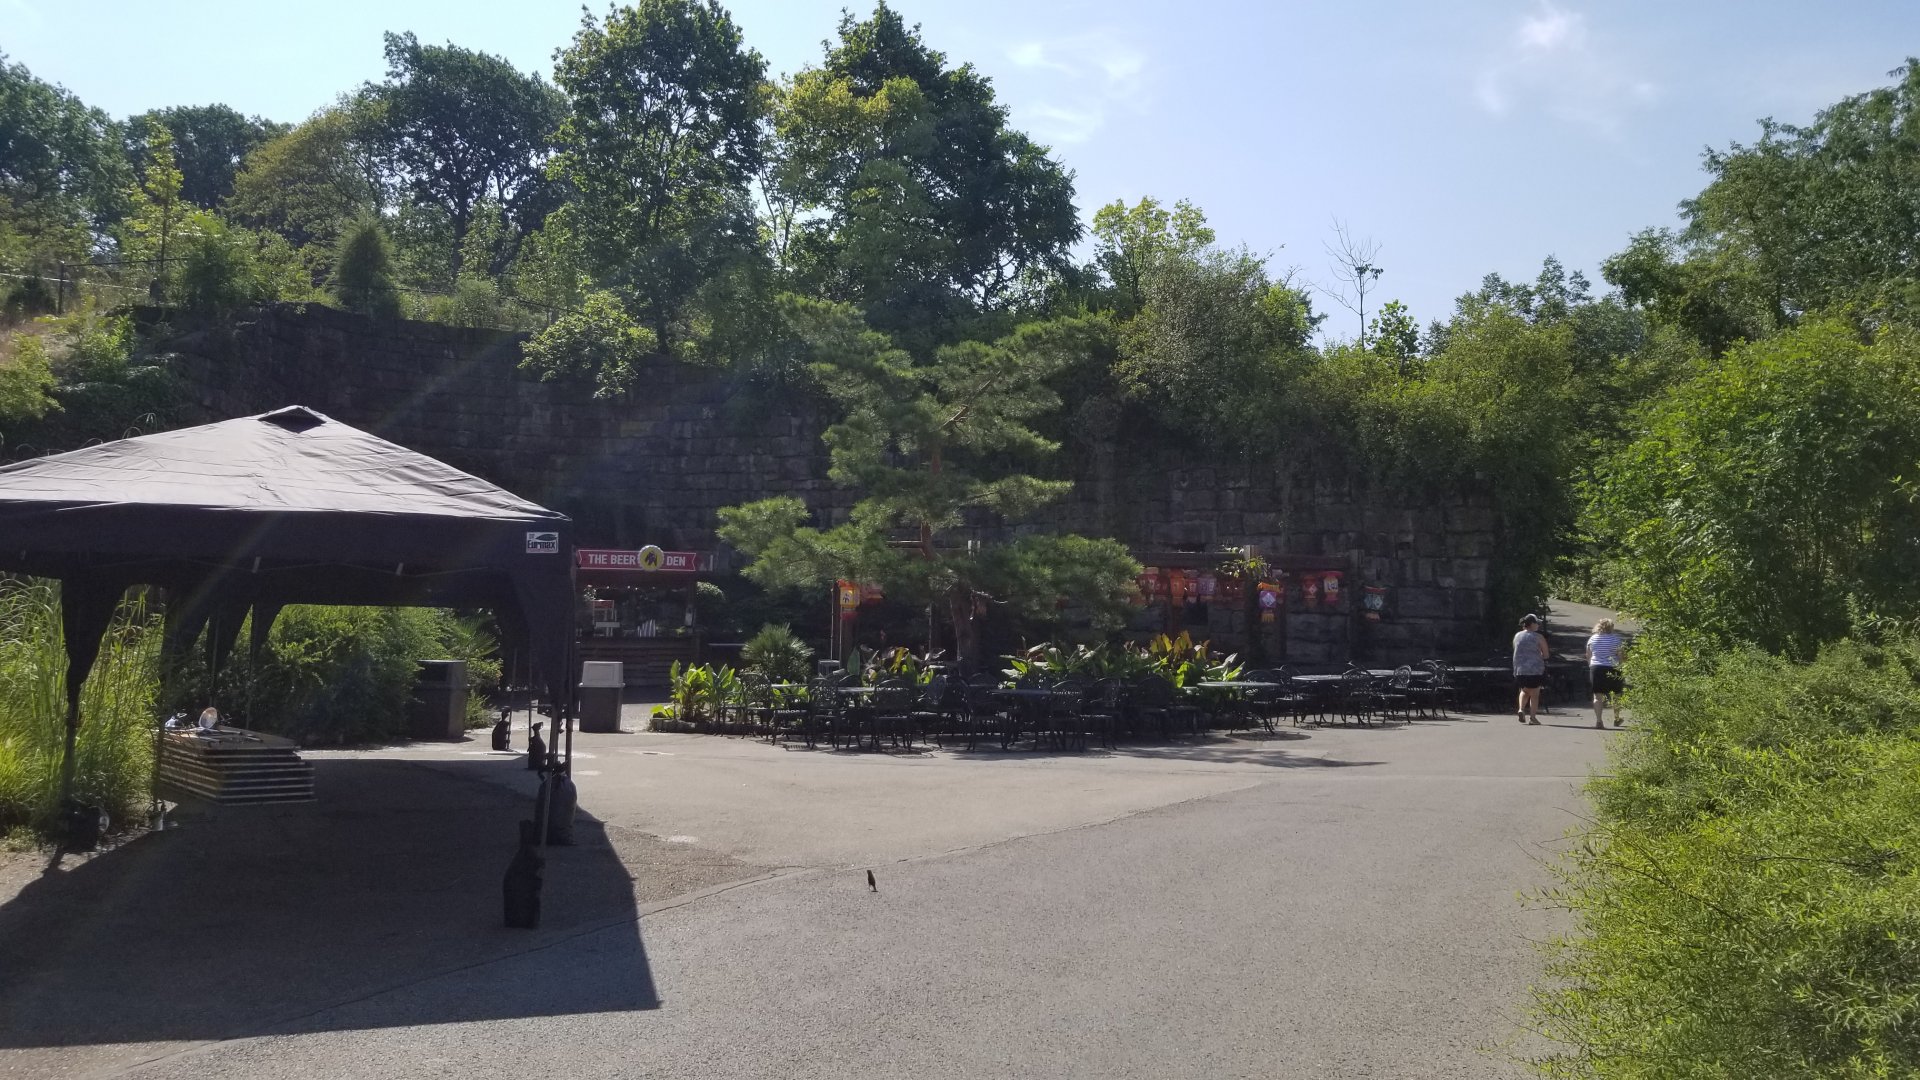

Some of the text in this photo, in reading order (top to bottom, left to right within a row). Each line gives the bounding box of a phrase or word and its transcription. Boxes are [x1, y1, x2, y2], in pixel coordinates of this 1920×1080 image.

[588, 554, 686, 566] THE BEER DEN
